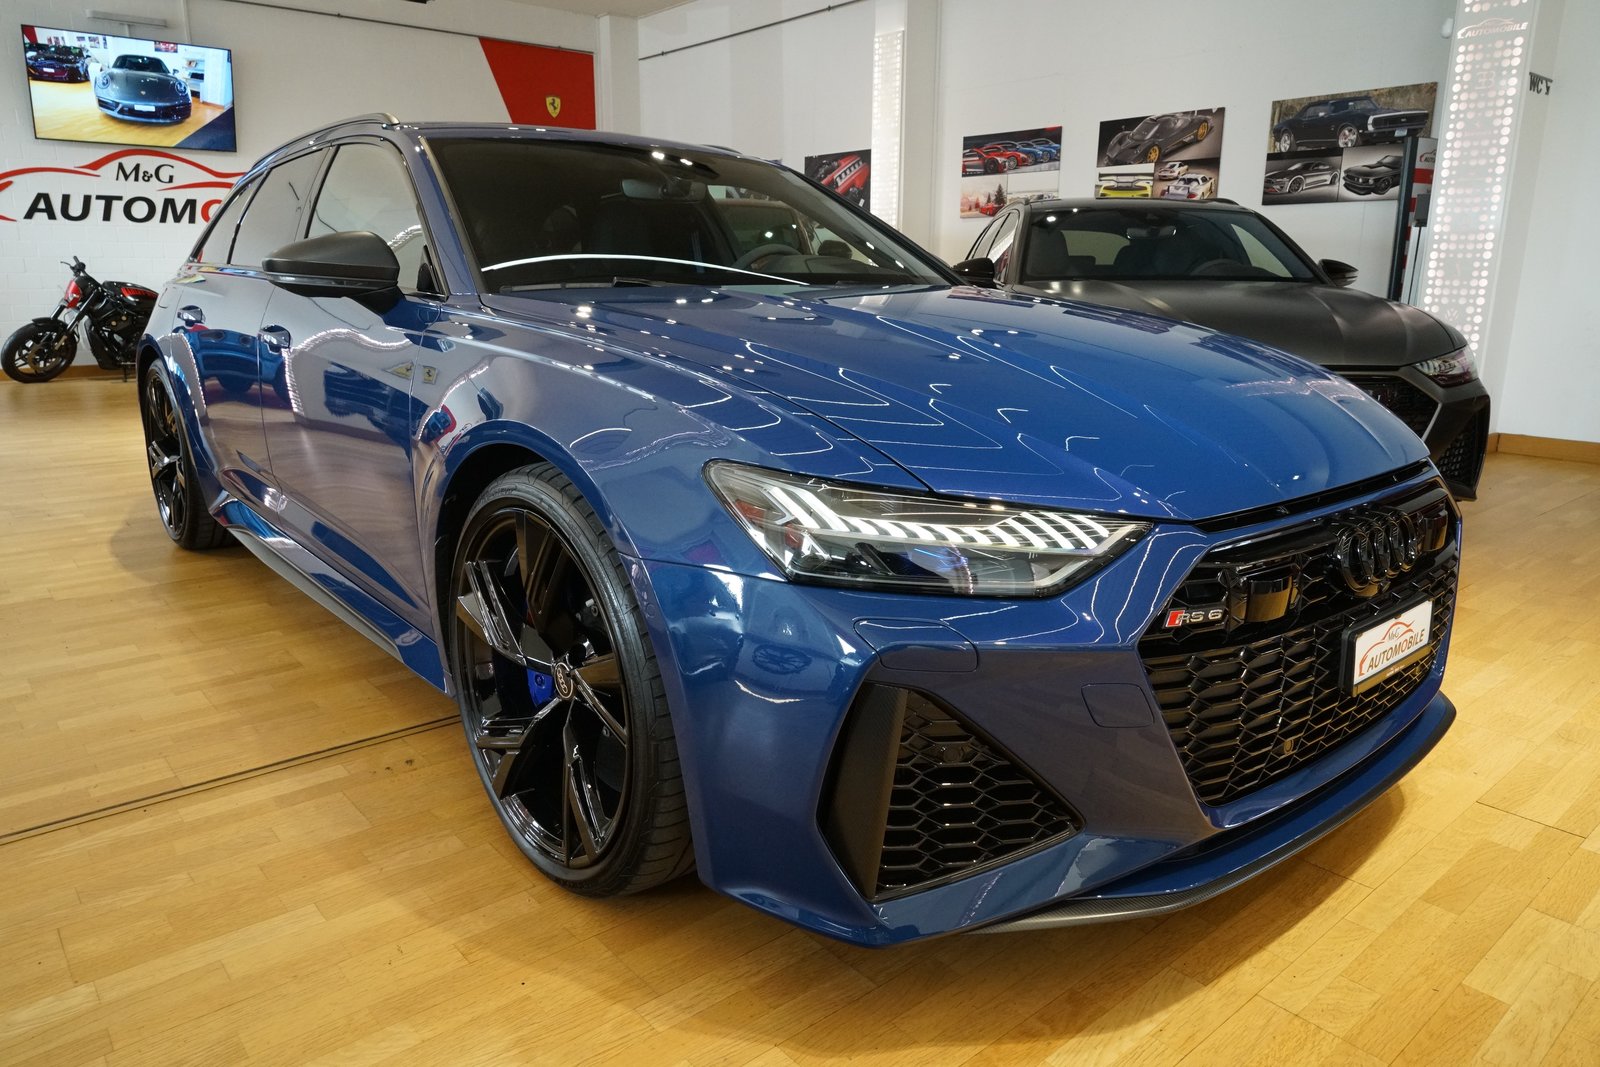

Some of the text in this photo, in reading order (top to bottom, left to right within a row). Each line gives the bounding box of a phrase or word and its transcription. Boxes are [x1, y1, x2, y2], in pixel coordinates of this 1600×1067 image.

[1529, 73, 1543, 94] WC
[115, 161, 175, 184] M&G
[1367, 628, 1425, 672] AUTOMOBILE
